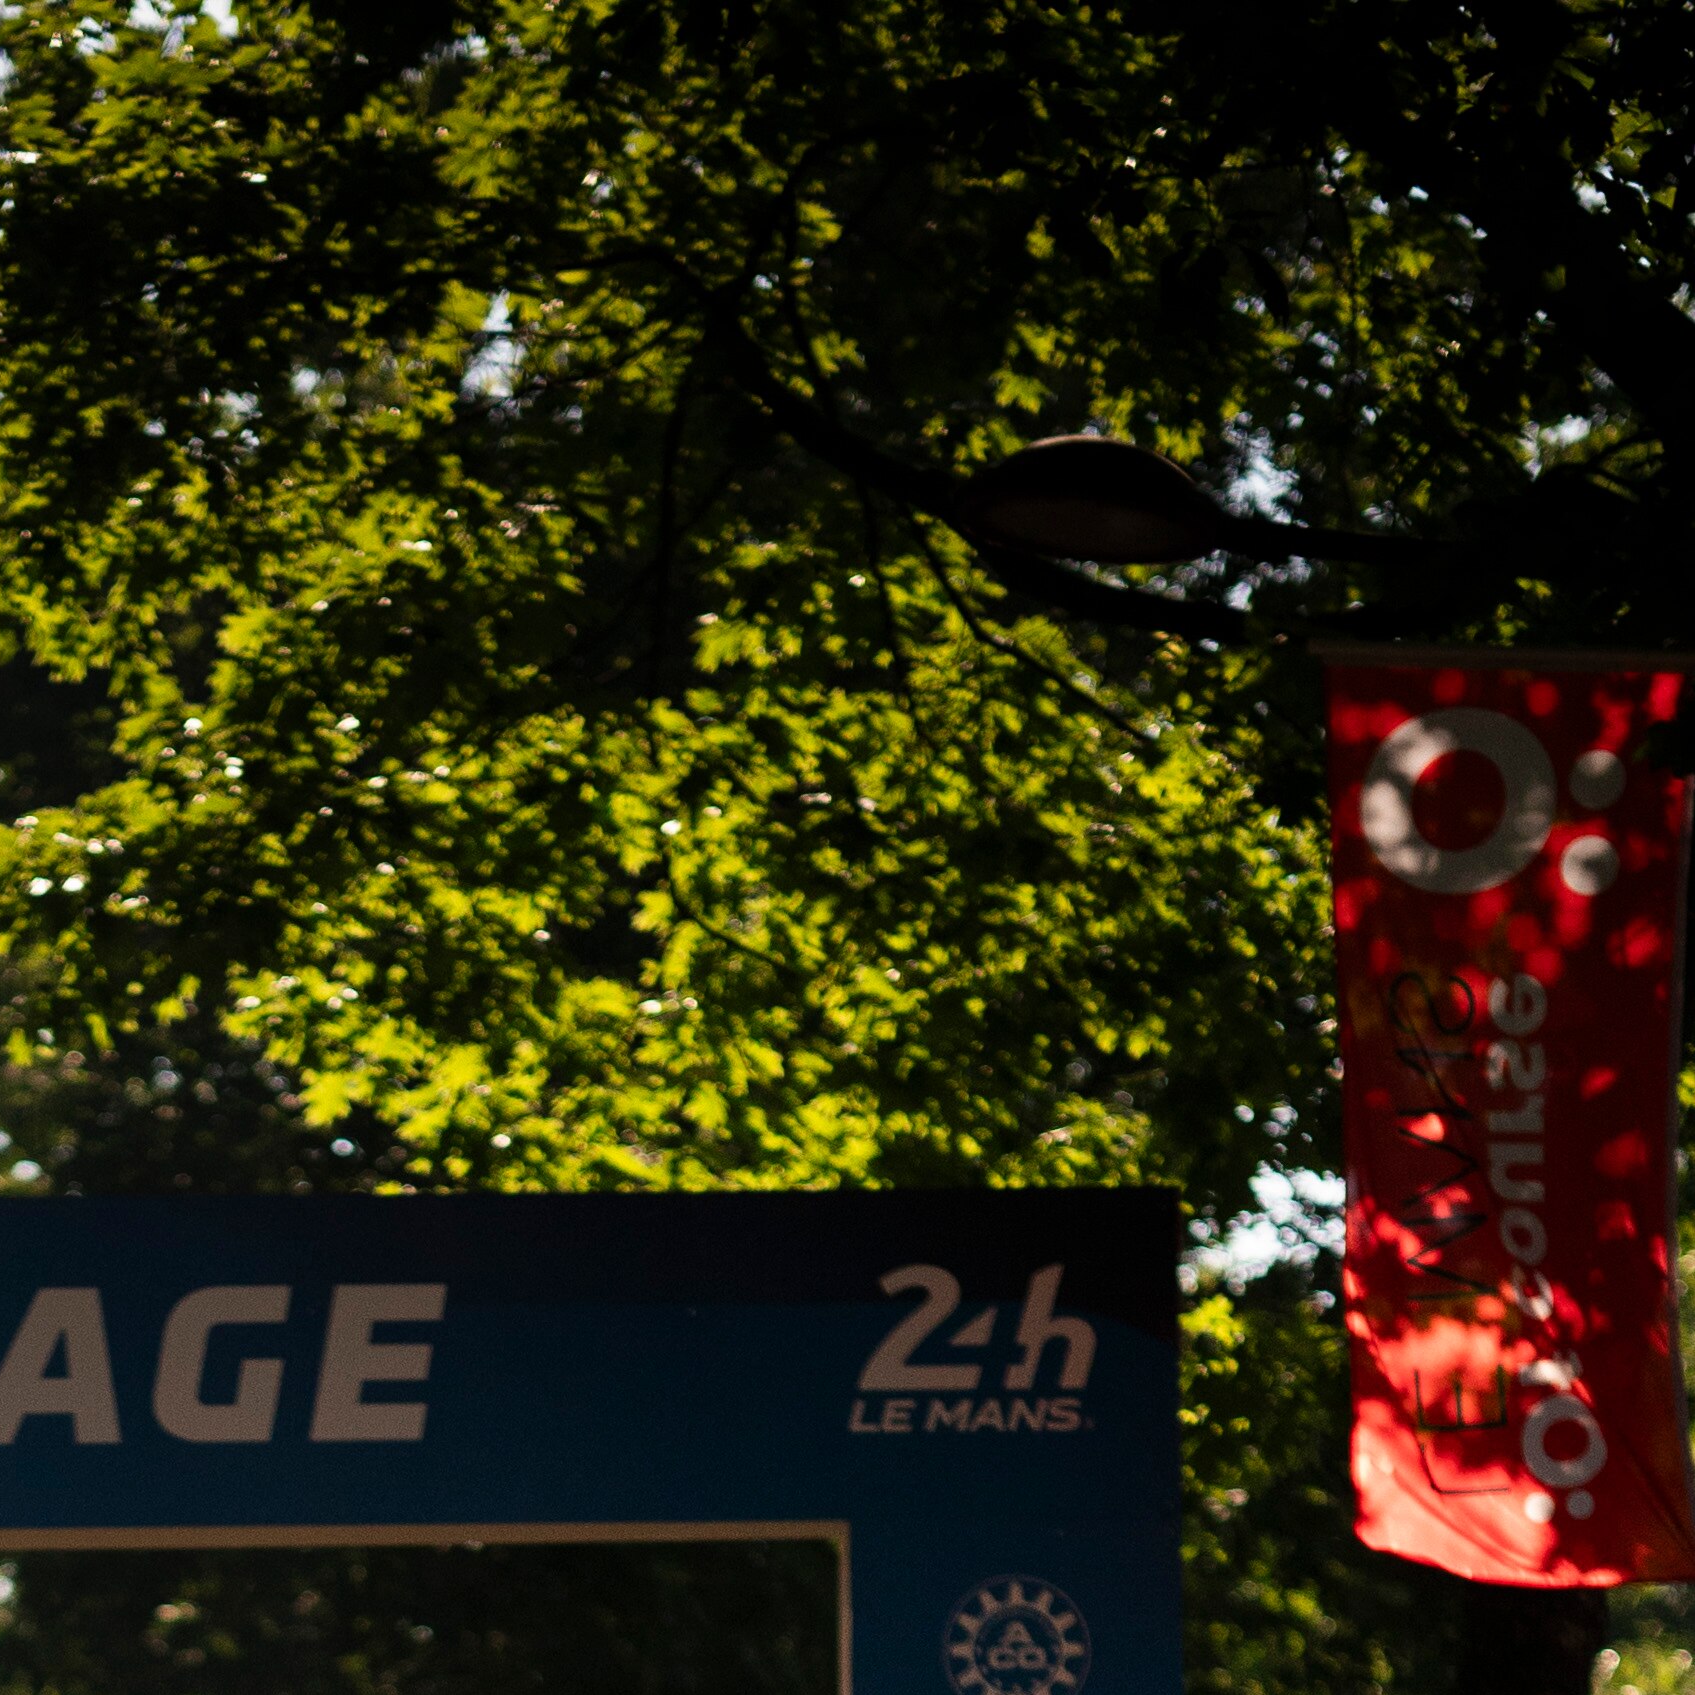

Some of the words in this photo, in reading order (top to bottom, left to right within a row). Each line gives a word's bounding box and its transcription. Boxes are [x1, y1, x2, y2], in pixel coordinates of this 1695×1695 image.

[855, 1261, 1099, 1392] 24h
[847, 1397, 917, 1434] LE
[922, 1396, 1084, 1433] MANS
